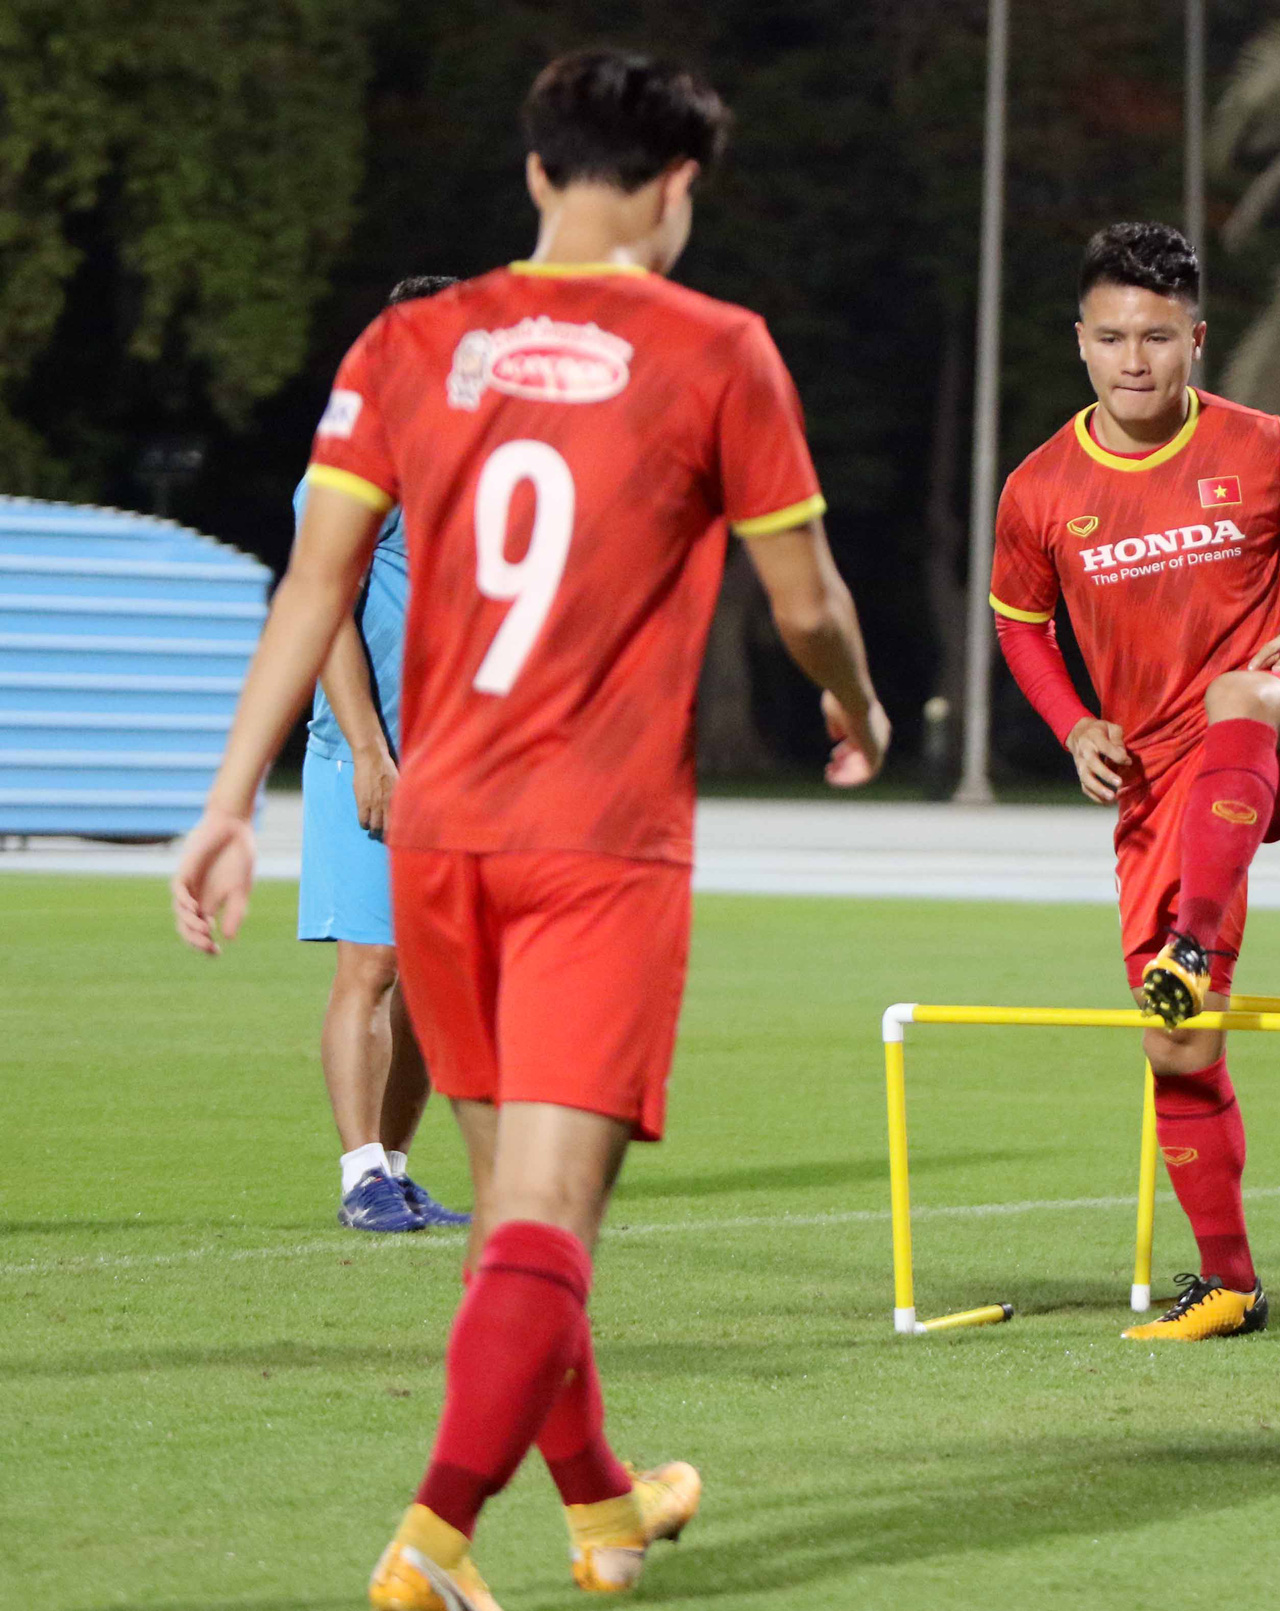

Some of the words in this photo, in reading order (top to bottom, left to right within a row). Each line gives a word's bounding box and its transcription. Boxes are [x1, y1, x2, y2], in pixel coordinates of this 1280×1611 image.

[472, 438, 576, 698] 9
[1079, 519, 1245, 572] HONDA
[1091, 573, 1119, 586] The
[1120, 560, 1165, 580] Power
[1168, 556, 1184, 568] of
[1187, 546, 1242, 565] Dreams
